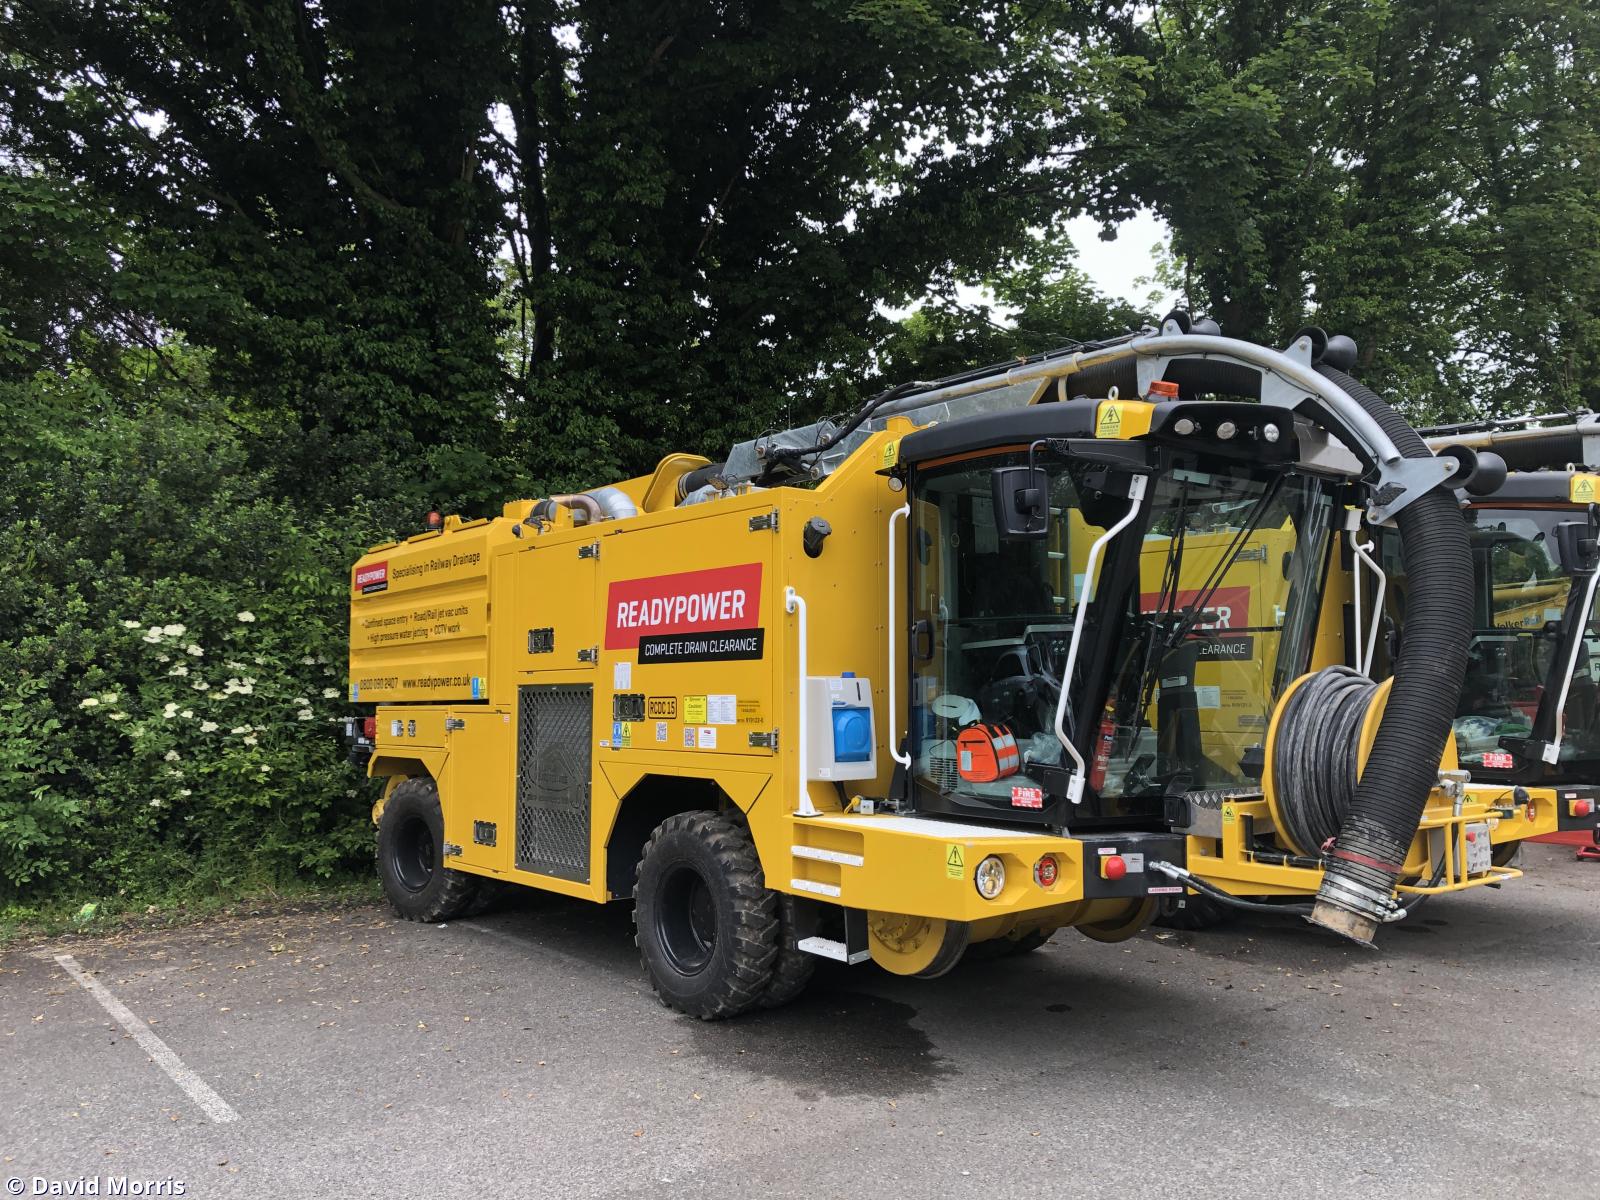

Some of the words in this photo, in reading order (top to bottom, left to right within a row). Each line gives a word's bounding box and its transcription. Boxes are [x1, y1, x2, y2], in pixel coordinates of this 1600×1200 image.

[392, 565, 423, 581] Specialising
[424, 562, 430, 572] in
[430, 558, 453, 571] Railway
[453, 552, 480, 566] Drainage
[365, 617, 383, 628] Confined
[384, 617, 396, 627] space
[397, 615, 408, 625] entry
[455, 605, 468, 616] units
[616, 589, 746, 628] READYPOWER
[380, 632, 399, 642] pressure
[399, 630, 413, 639] water
[412, 627, 428, 640] jetting
[434, 624, 448, 635] CCTV
[447, 621, 460, 632] work
[644, 642, 683, 656] COMPLETE
[684, 640, 708, 654] DRAIN
[709, 637, 758, 653] CLEARANCE
[402, 673, 471, 692] www.readypower.co.uk
[667, 701, 675, 715] 15
[1018, 790, 1036, 799] FIRE
